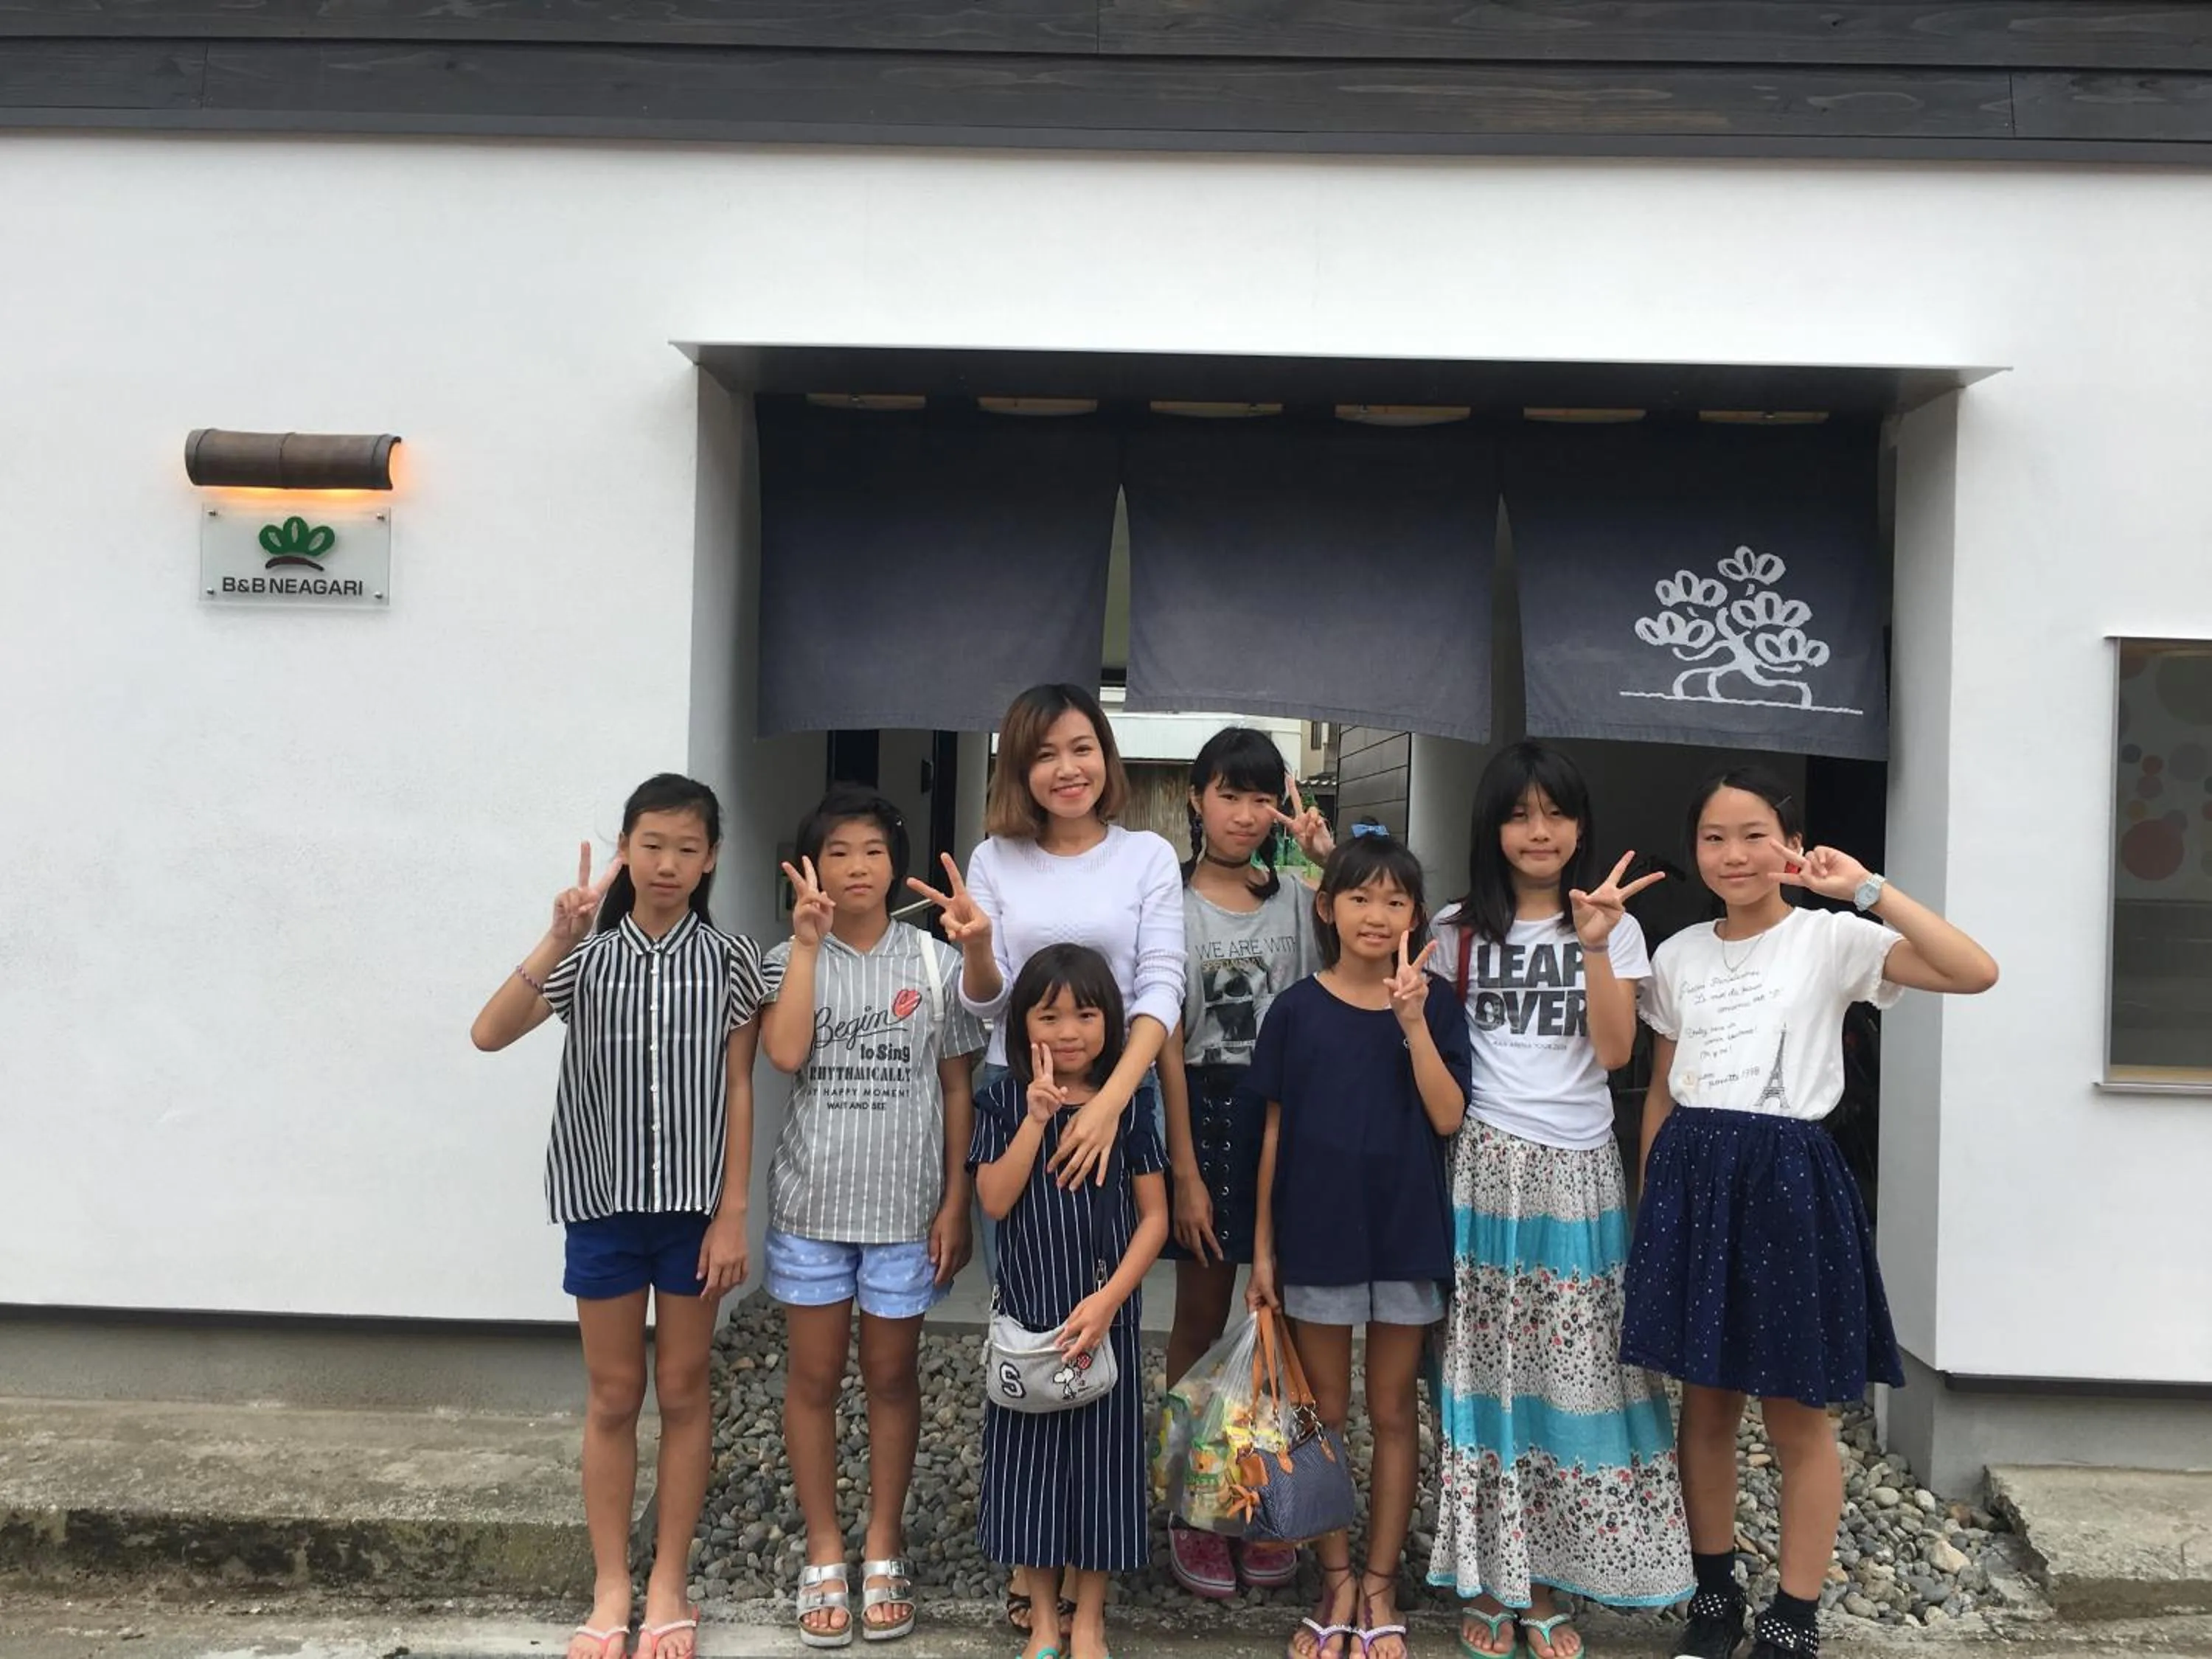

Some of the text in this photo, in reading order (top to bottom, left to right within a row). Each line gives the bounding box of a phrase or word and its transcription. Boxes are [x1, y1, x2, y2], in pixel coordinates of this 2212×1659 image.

[223, 577, 363, 596] B&B NEAGARI
[1195, 942, 1224, 959] WE
[1229, 939, 1262, 957] ARE
[1477, 942, 1586, 988] LEAP
[1475, 990, 1587, 1036] OVER
[813, 1006, 895, 1051] Begin
[877, 1043, 911, 1062] Sing
[823, 1088, 858, 1096] HAPPY
[849, 1102, 869, 1110] AND
[1000, 1362, 1026, 1399] S
